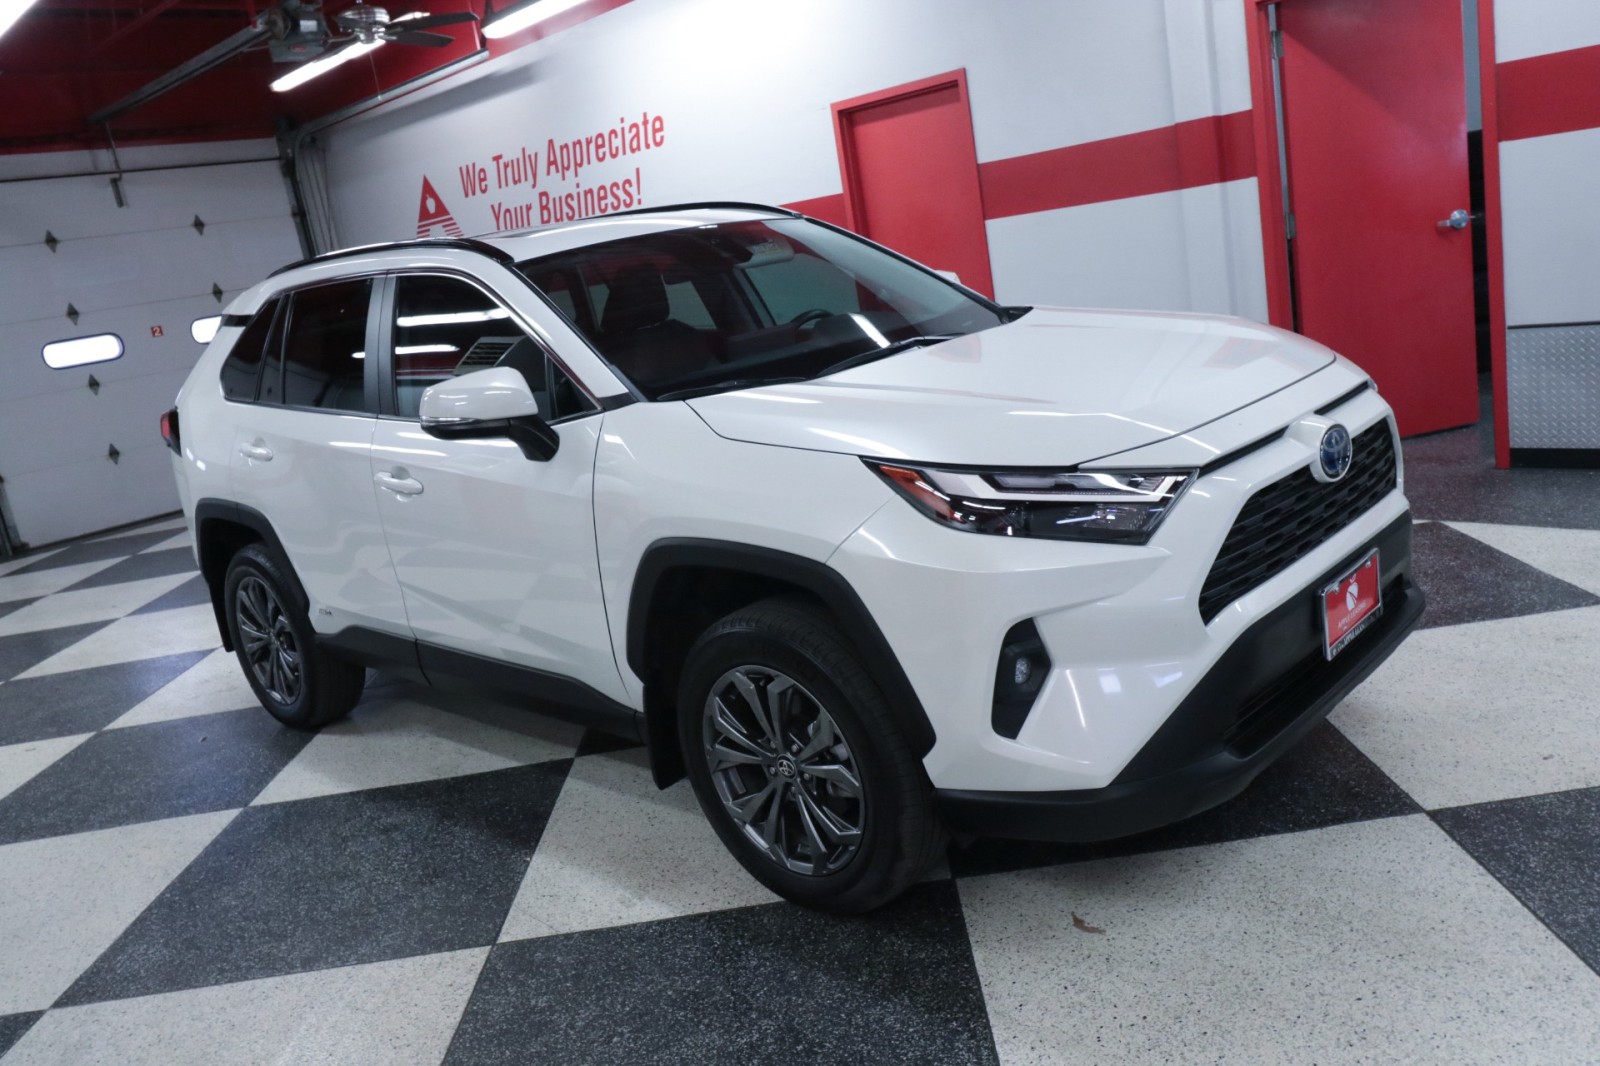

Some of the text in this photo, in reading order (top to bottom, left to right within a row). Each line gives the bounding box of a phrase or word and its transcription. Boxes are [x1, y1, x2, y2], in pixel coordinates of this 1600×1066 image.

[459, 112, 665, 198] We Truly Appreciate
[491, 167, 642, 231] Your Business!
[153, 326, 162, 337] 2
